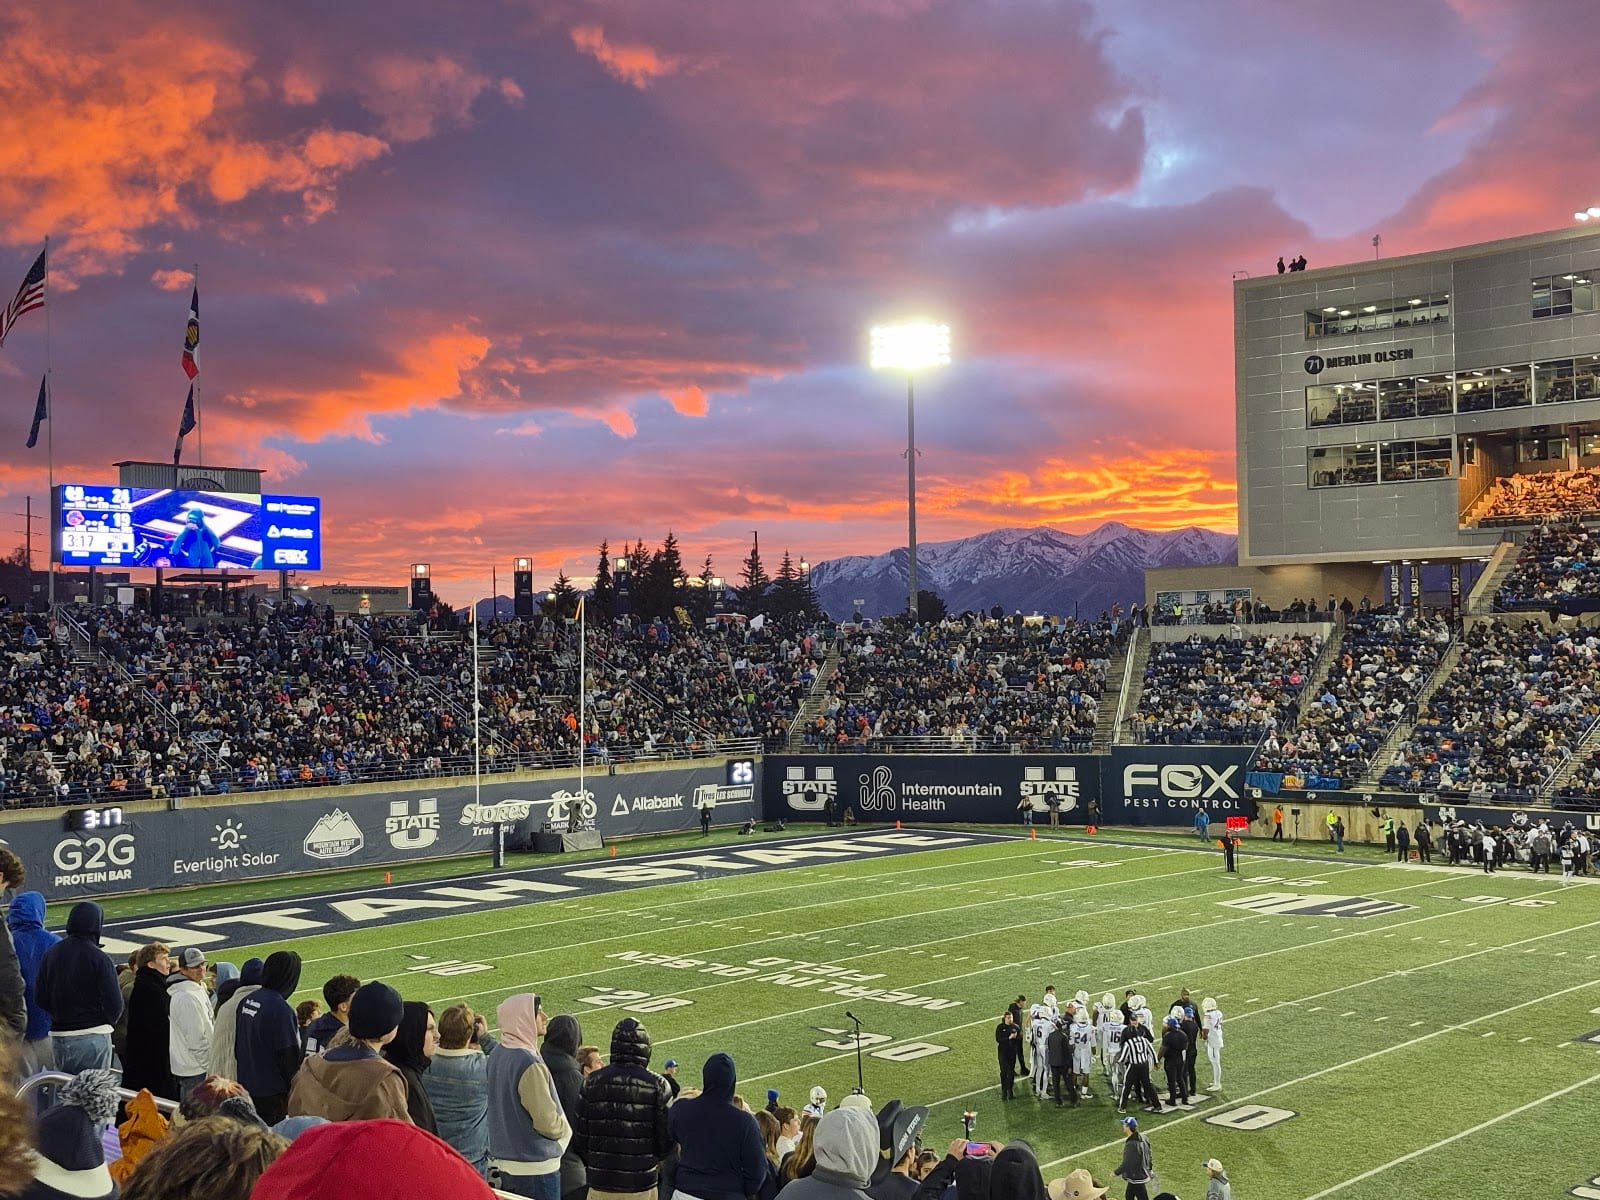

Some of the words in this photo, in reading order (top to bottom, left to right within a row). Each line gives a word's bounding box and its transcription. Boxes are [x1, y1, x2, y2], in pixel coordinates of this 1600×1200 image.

[1307, 359, 1320, 371] 71
[1326, 353, 1372, 369] MERLIN
[1374, 348, 1414, 363] OLSEN
[113, 512, 130, 527] 19
[67, 533, 94, 547] 3:17
[1390, 577, 1400, 597] USU
[1411, 578, 1420, 597] USU
[1451, 577, 1460, 596] USU
[732, 761, 753, 783] 25
[1123, 763, 1240, 799] FOX
[782, 780, 838, 796] STATE
[902, 782, 1002, 797] Intermountain
[1020, 781, 1080, 797] STATE
[632, 793, 684, 812] Altabank
[902, 798, 946, 811] Health
[1124, 798, 1159, 808] PEST
[1167, 799, 1240, 809] CONTROL
[83, 807, 122, 829] 3:17
[385, 813, 440, 834] STATE
[53, 833, 135, 871] G2G
[173, 855, 239, 874] Everlight
[241, 852, 280, 867] Solar
[55, 871, 107, 887] PROTEIN
[108, 868, 132, 881] BAR
[98, 878, 582, 955] UTAH
[561, 833, 976, 882] STATE
[405, 959, 496, 976] 10
[605, 949, 760, 977] OLSEN
[747, 956, 888, 982] FIELD
[576, 989, 695, 1013] 20
[756, 972, 966, 1011] MERLIN
[813, 1030, 951, 1062] 30
[1074, 1031, 1088, 1045] 24
[1109, 1030, 1121, 1044] 16
